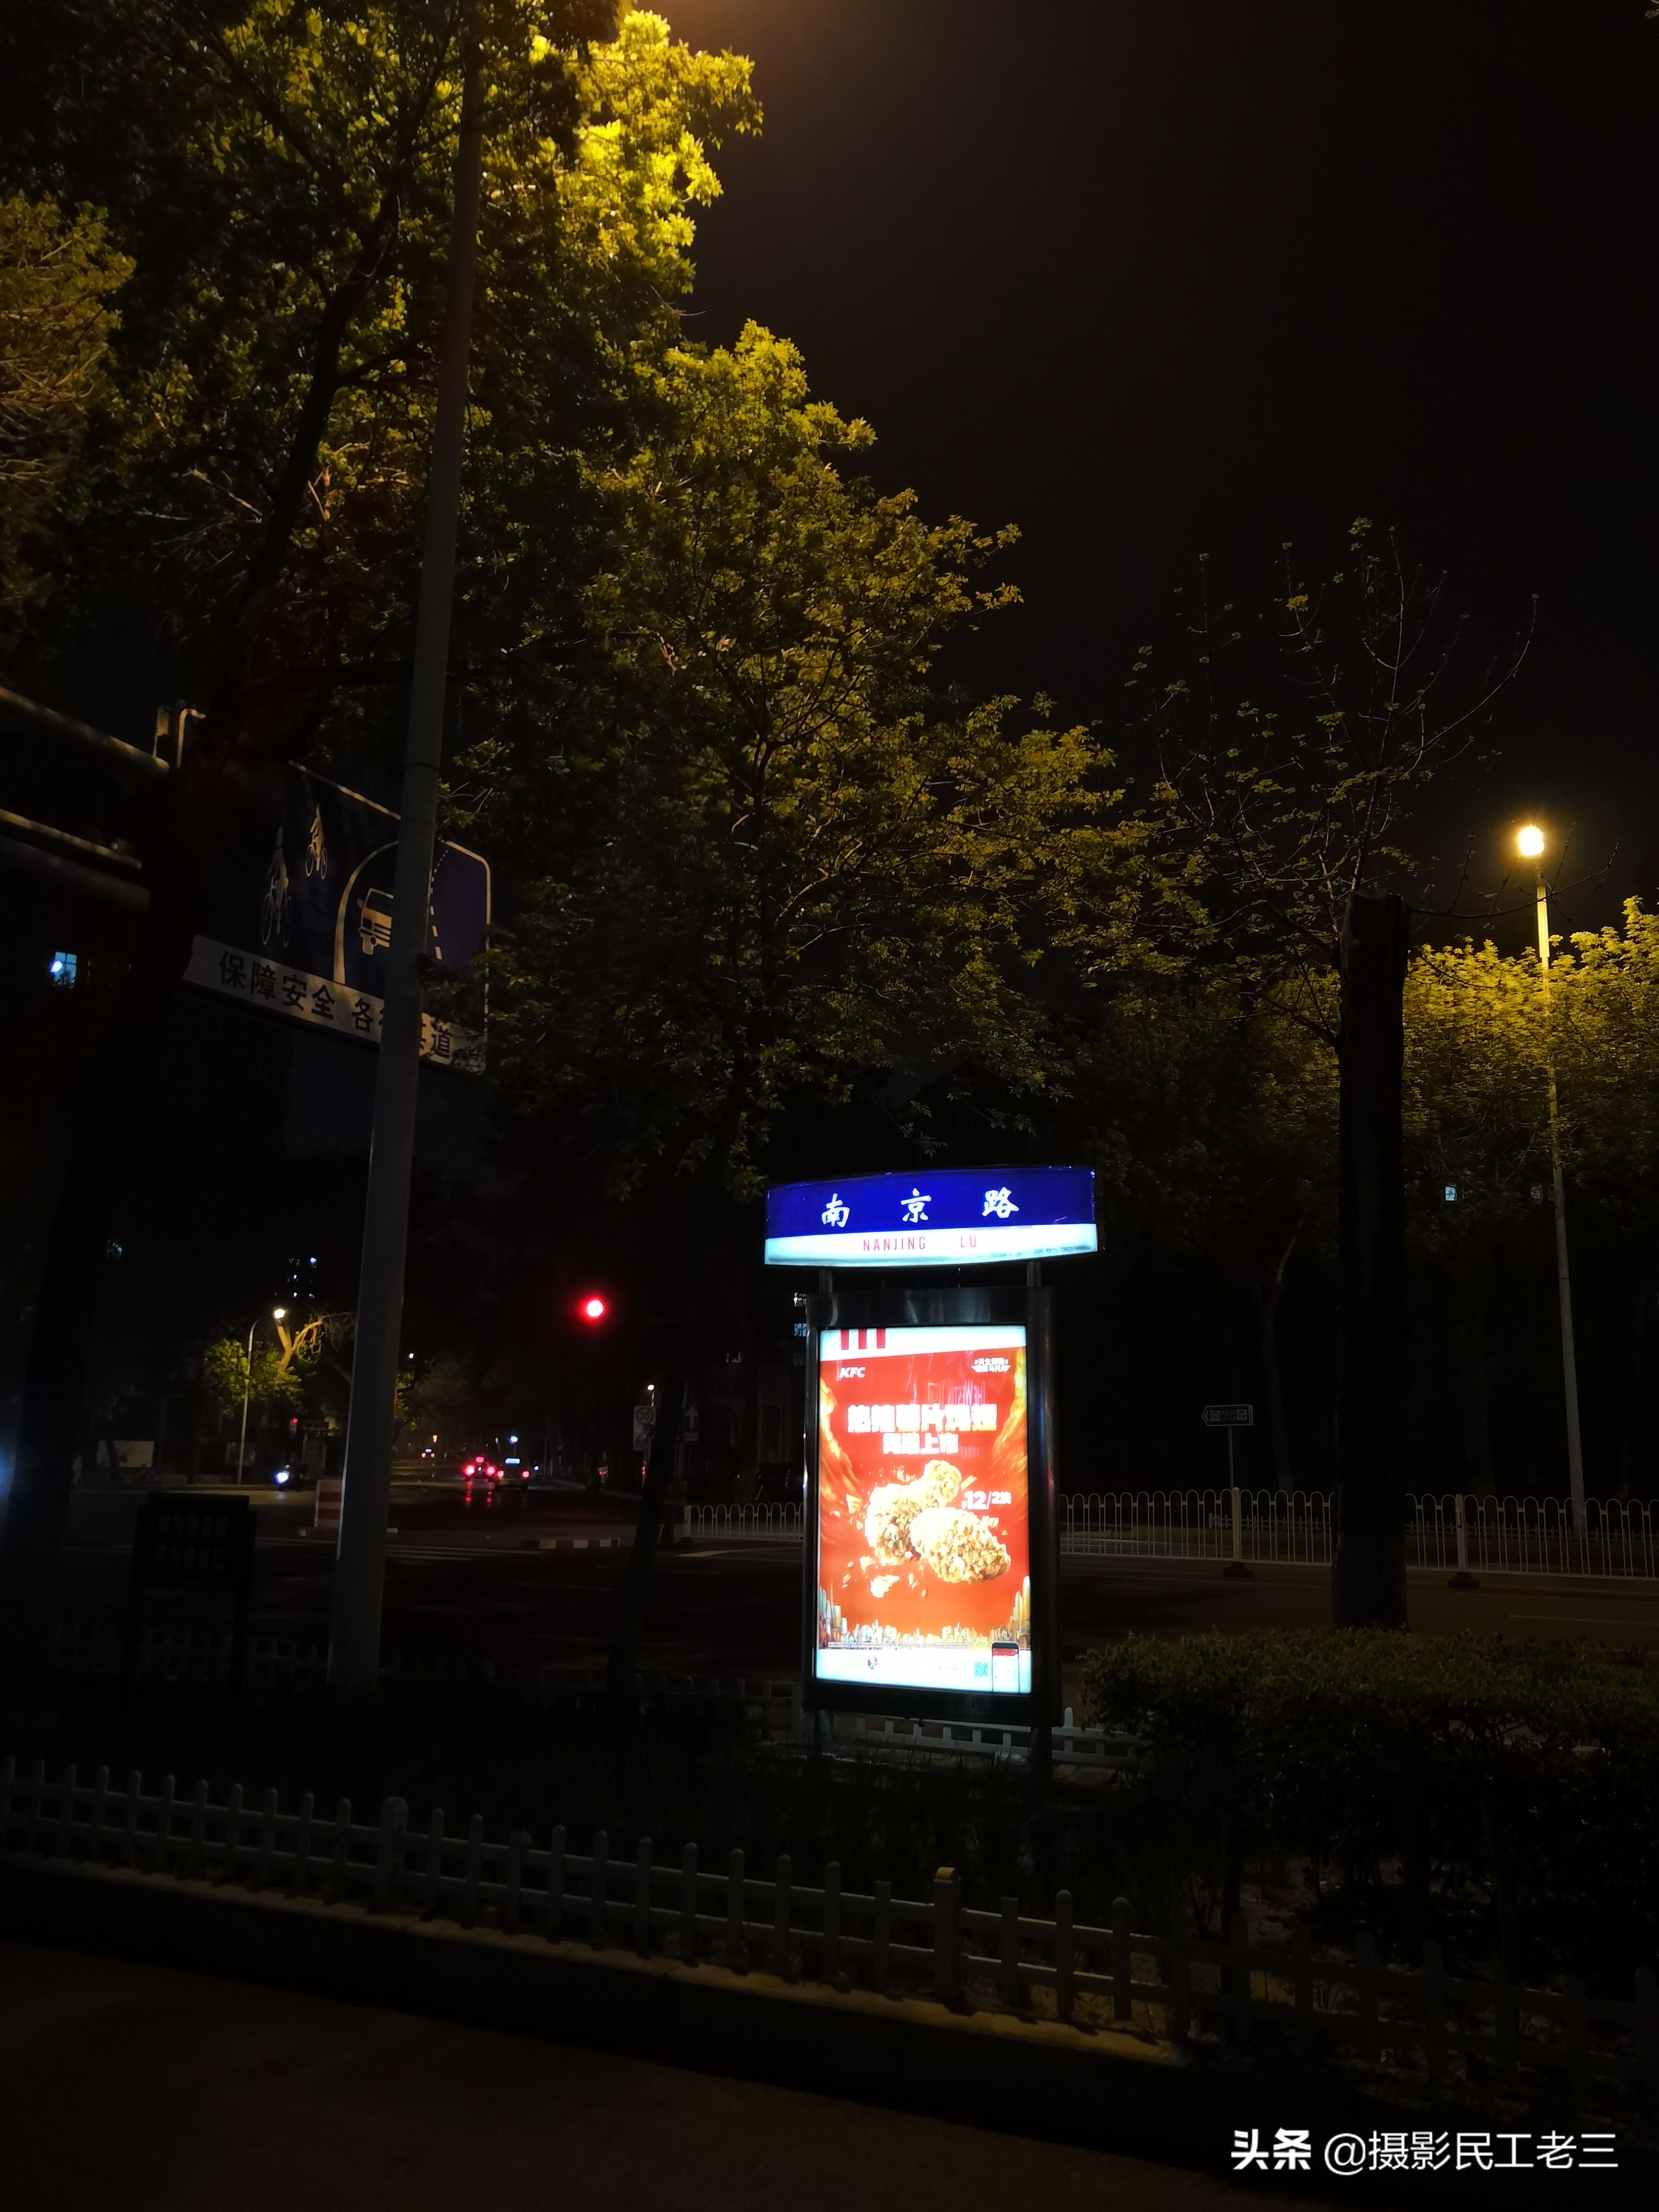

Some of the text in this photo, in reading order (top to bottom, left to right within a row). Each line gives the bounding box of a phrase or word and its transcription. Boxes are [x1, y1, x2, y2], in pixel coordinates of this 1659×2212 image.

[219, 950, 451, 1058] 保障安全 各道
[821, 1187, 1020, 1228] 南京路
[863, 1235, 977, 1251] NANJING LU
[839, 1367, 866, 1379] KFC
[882, 1432, 959, 1455] 上市
